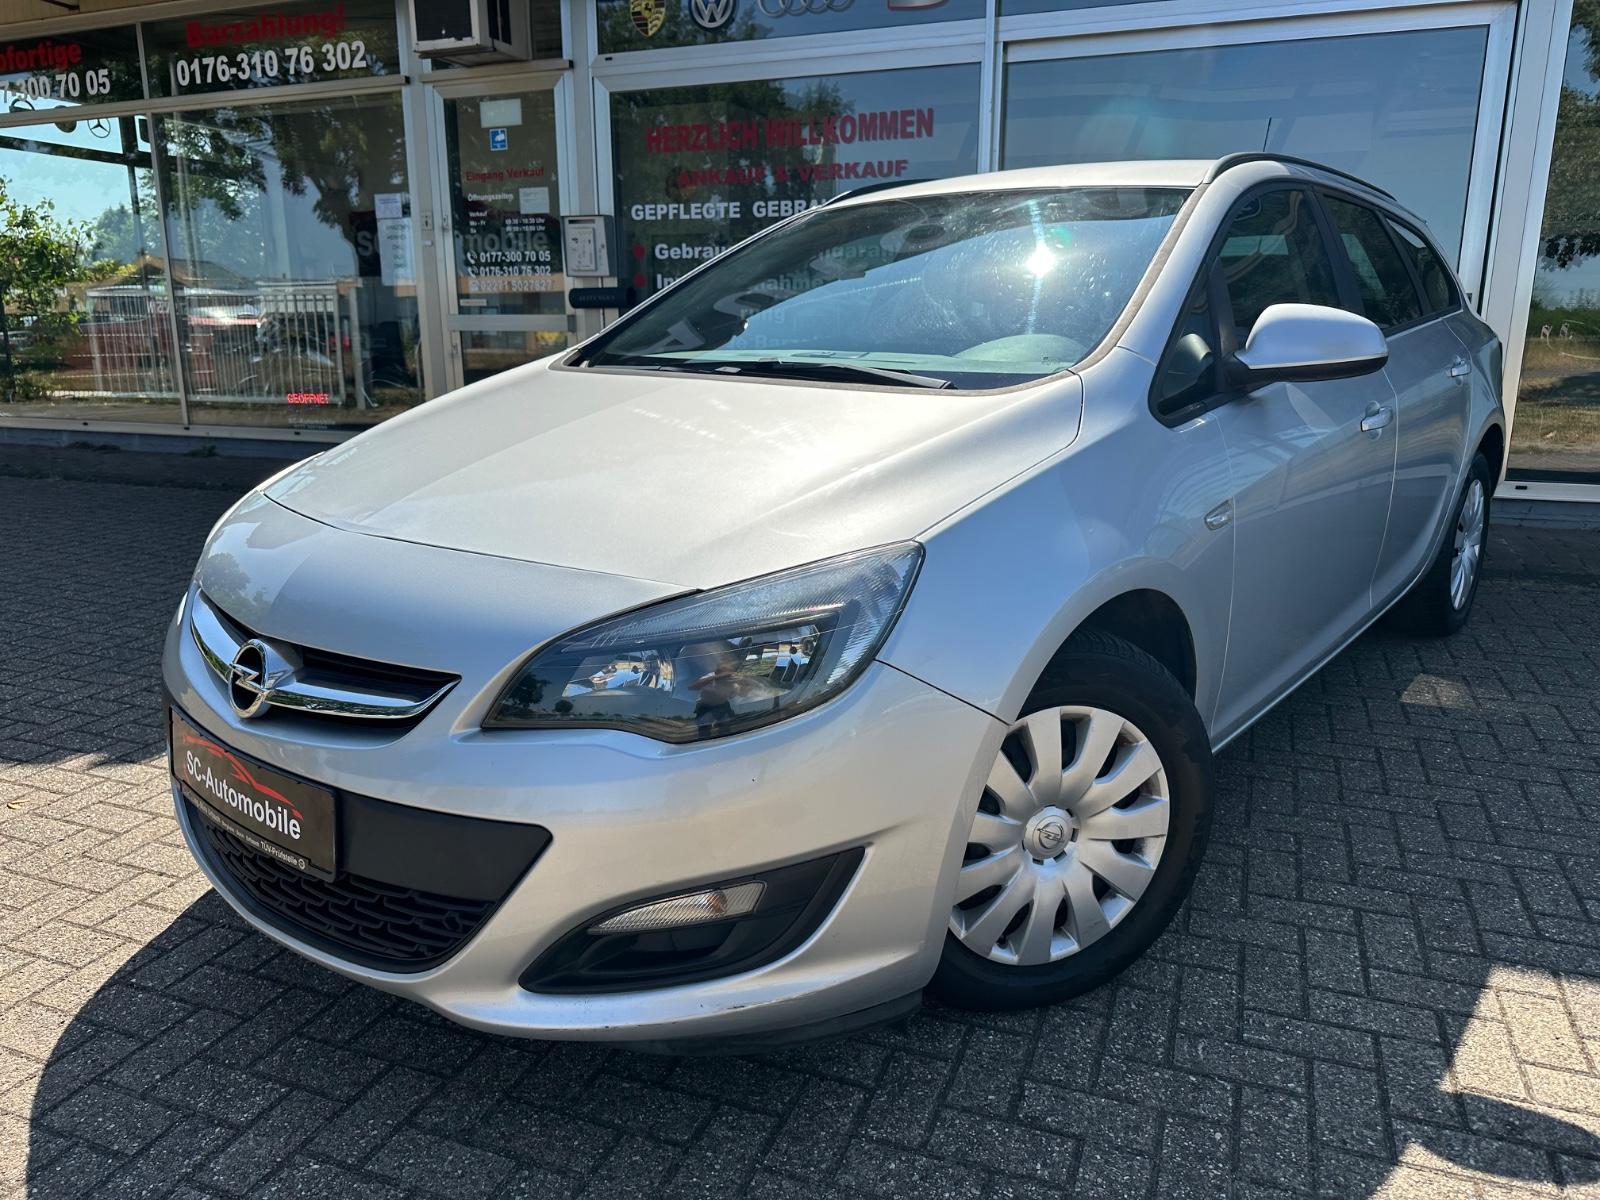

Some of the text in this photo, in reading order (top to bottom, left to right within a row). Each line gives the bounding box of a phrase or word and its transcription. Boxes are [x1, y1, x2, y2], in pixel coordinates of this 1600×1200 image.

[186, 4, 345, 48] Barzahlung!
[176, 40, 367, 87] 0176-310 76 302
[56, 72, 80, 98] 70
[86, 68, 111, 95] 05
[646, 107, 934, 152] HERZLICH WILLKOMMEN
[466, 167, 545, 184] Eingang Verkauf
[675, 166, 766, 188] ANKAUF
[800, 159, 909, 182] VERKAUF
[631, 200, 741, 221] GEPFLEGTE
[479, 265, 551, 277] 0176-310 76 302
[480, 250, 551, 263] 0177-300 70 05
[187, 750, 301, 840] SC-Automobile
